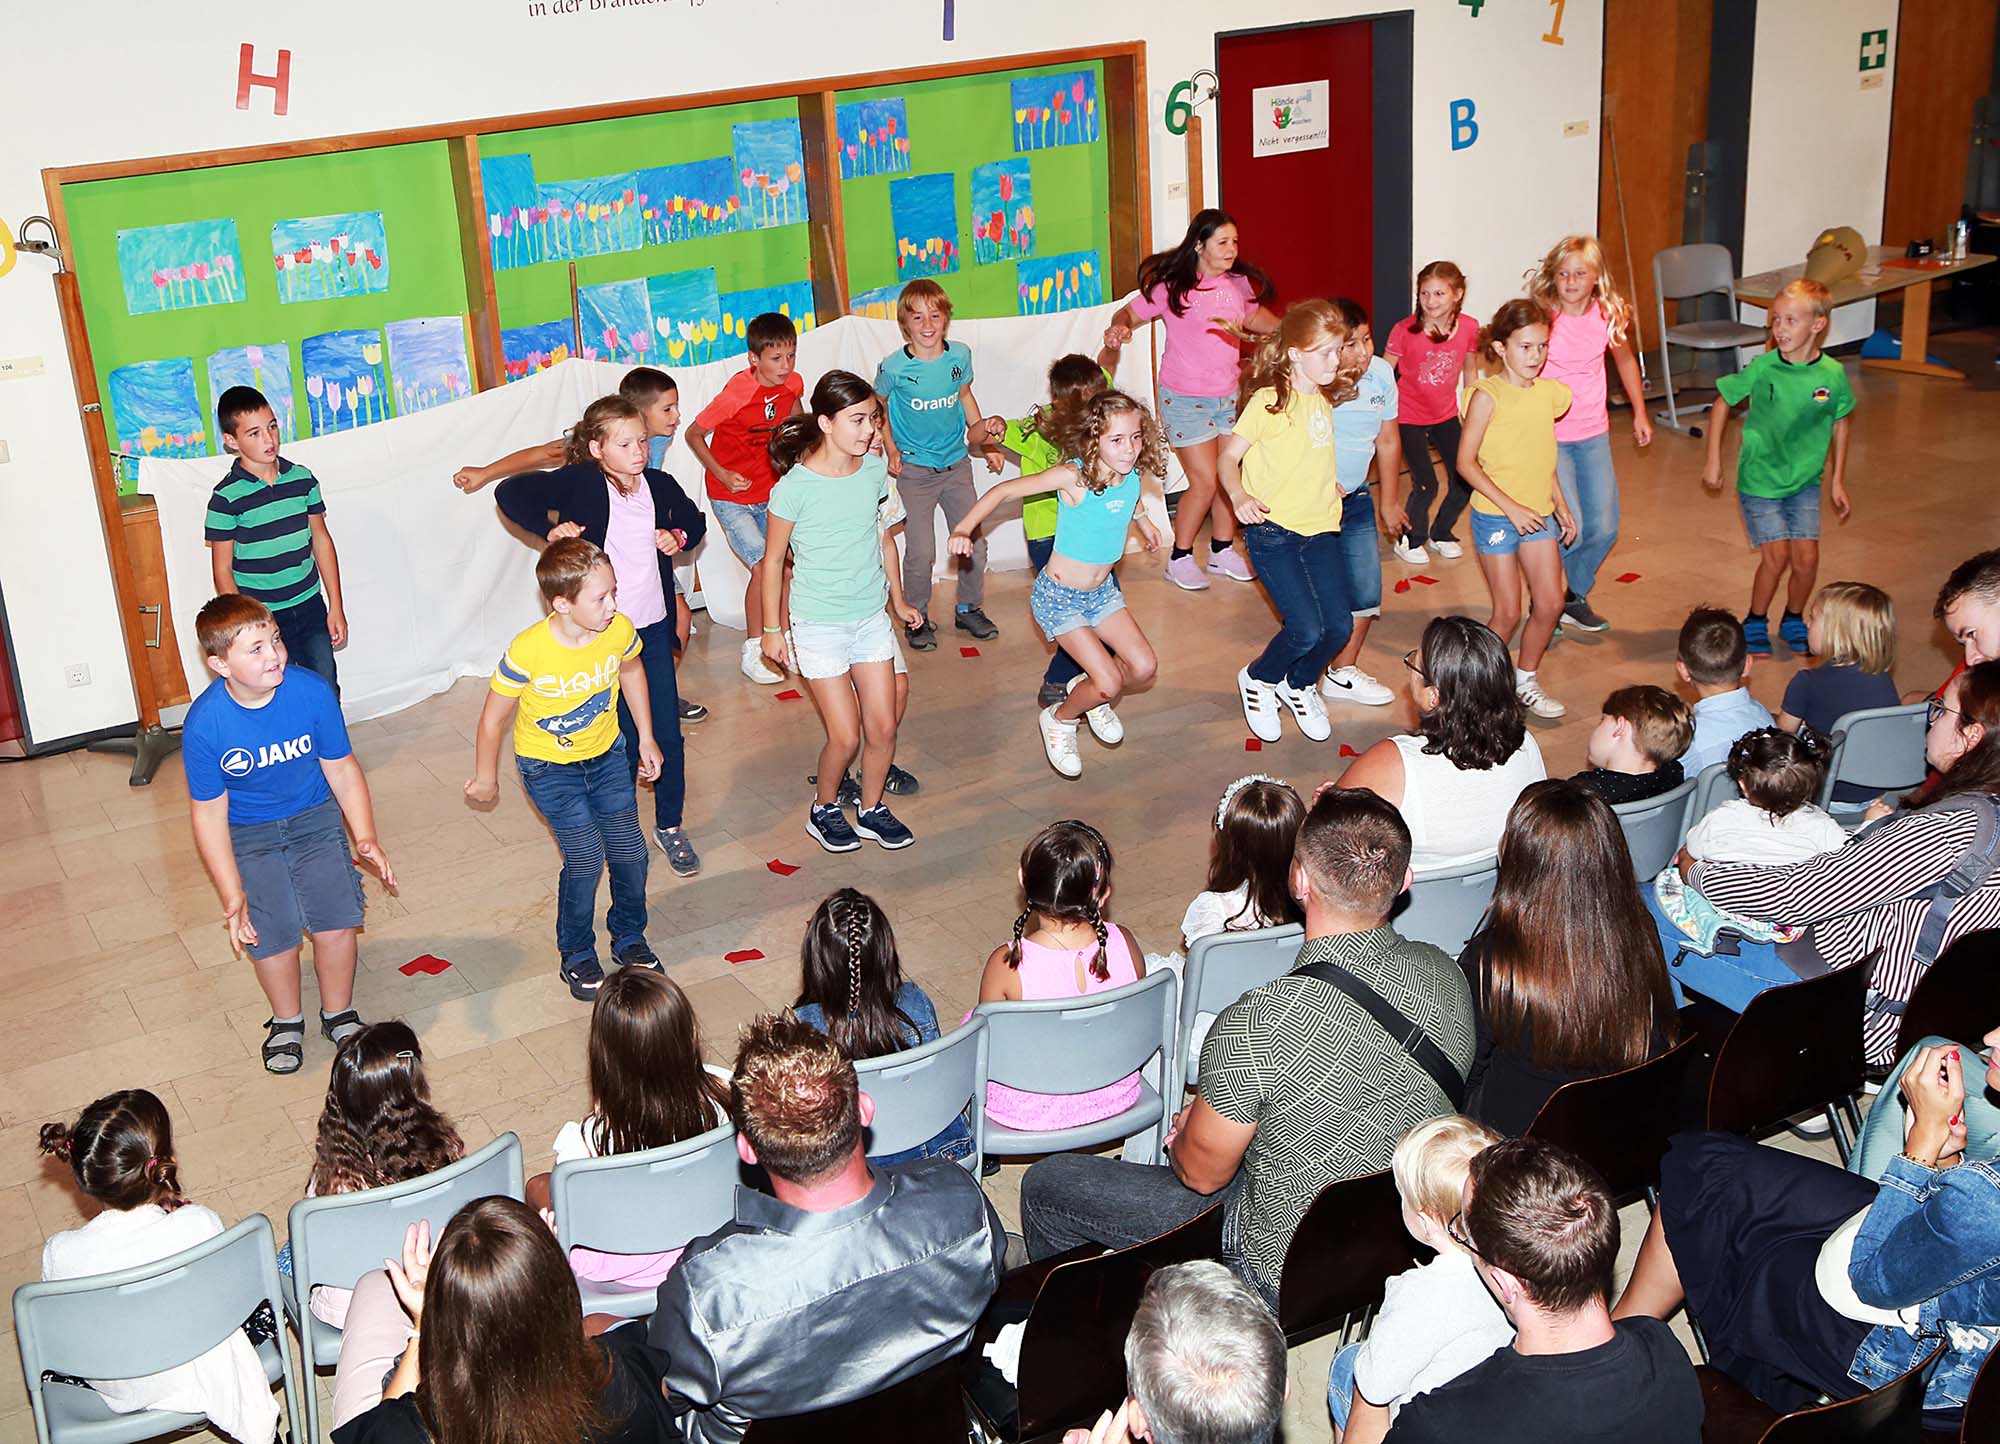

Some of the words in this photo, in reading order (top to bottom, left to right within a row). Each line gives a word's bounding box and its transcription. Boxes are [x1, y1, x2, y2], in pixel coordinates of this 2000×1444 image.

[528, 1, 546, 17] in
[553, 0, 584, 15] der
[235, 43, 291, 116] H
[1165, 80, 1198, 136] 6
[1450, 98, 1479, 151] B
[1259, 136, 1279, 146] Nicht
[257, 734, 312, 769] JAKO
